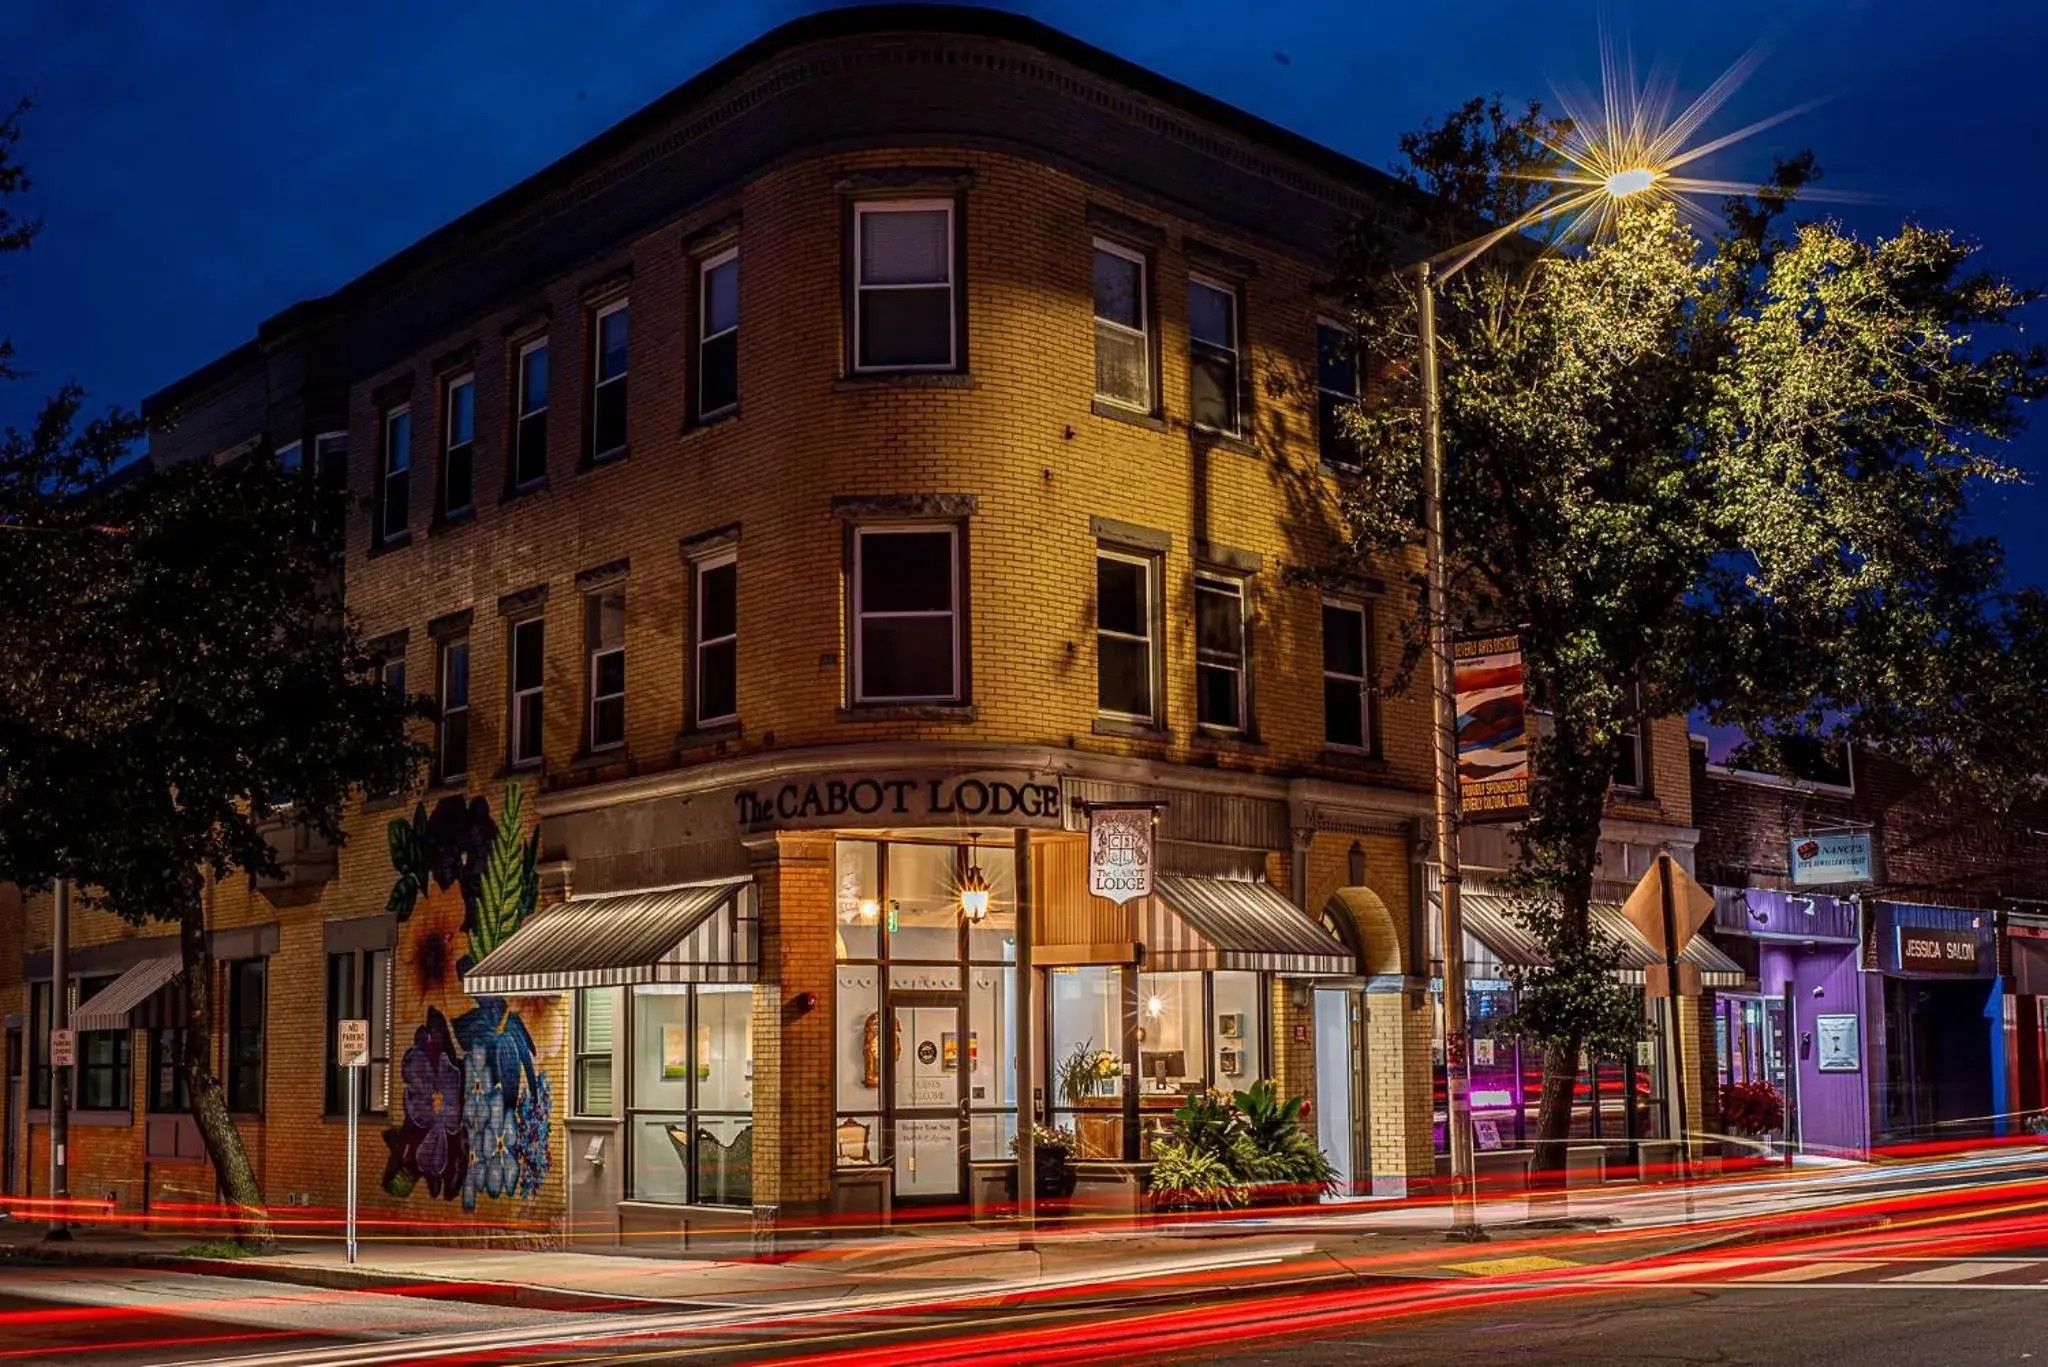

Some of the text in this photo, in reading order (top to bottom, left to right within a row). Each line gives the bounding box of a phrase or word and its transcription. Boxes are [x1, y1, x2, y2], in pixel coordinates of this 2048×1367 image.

[1485, 780, 1518, 796] SPONSORED
[1519, 779, 1528, 792] BY
[735, 778, 1060, 825] The CABOT LODGE
[1096, 878, 1145, 890] LODGE
[1905, 939, 1975, 961] JESSICA SALON
[349, 1023, 358, 1032] NO
[342, 1033, 366, 1041] PARKING
